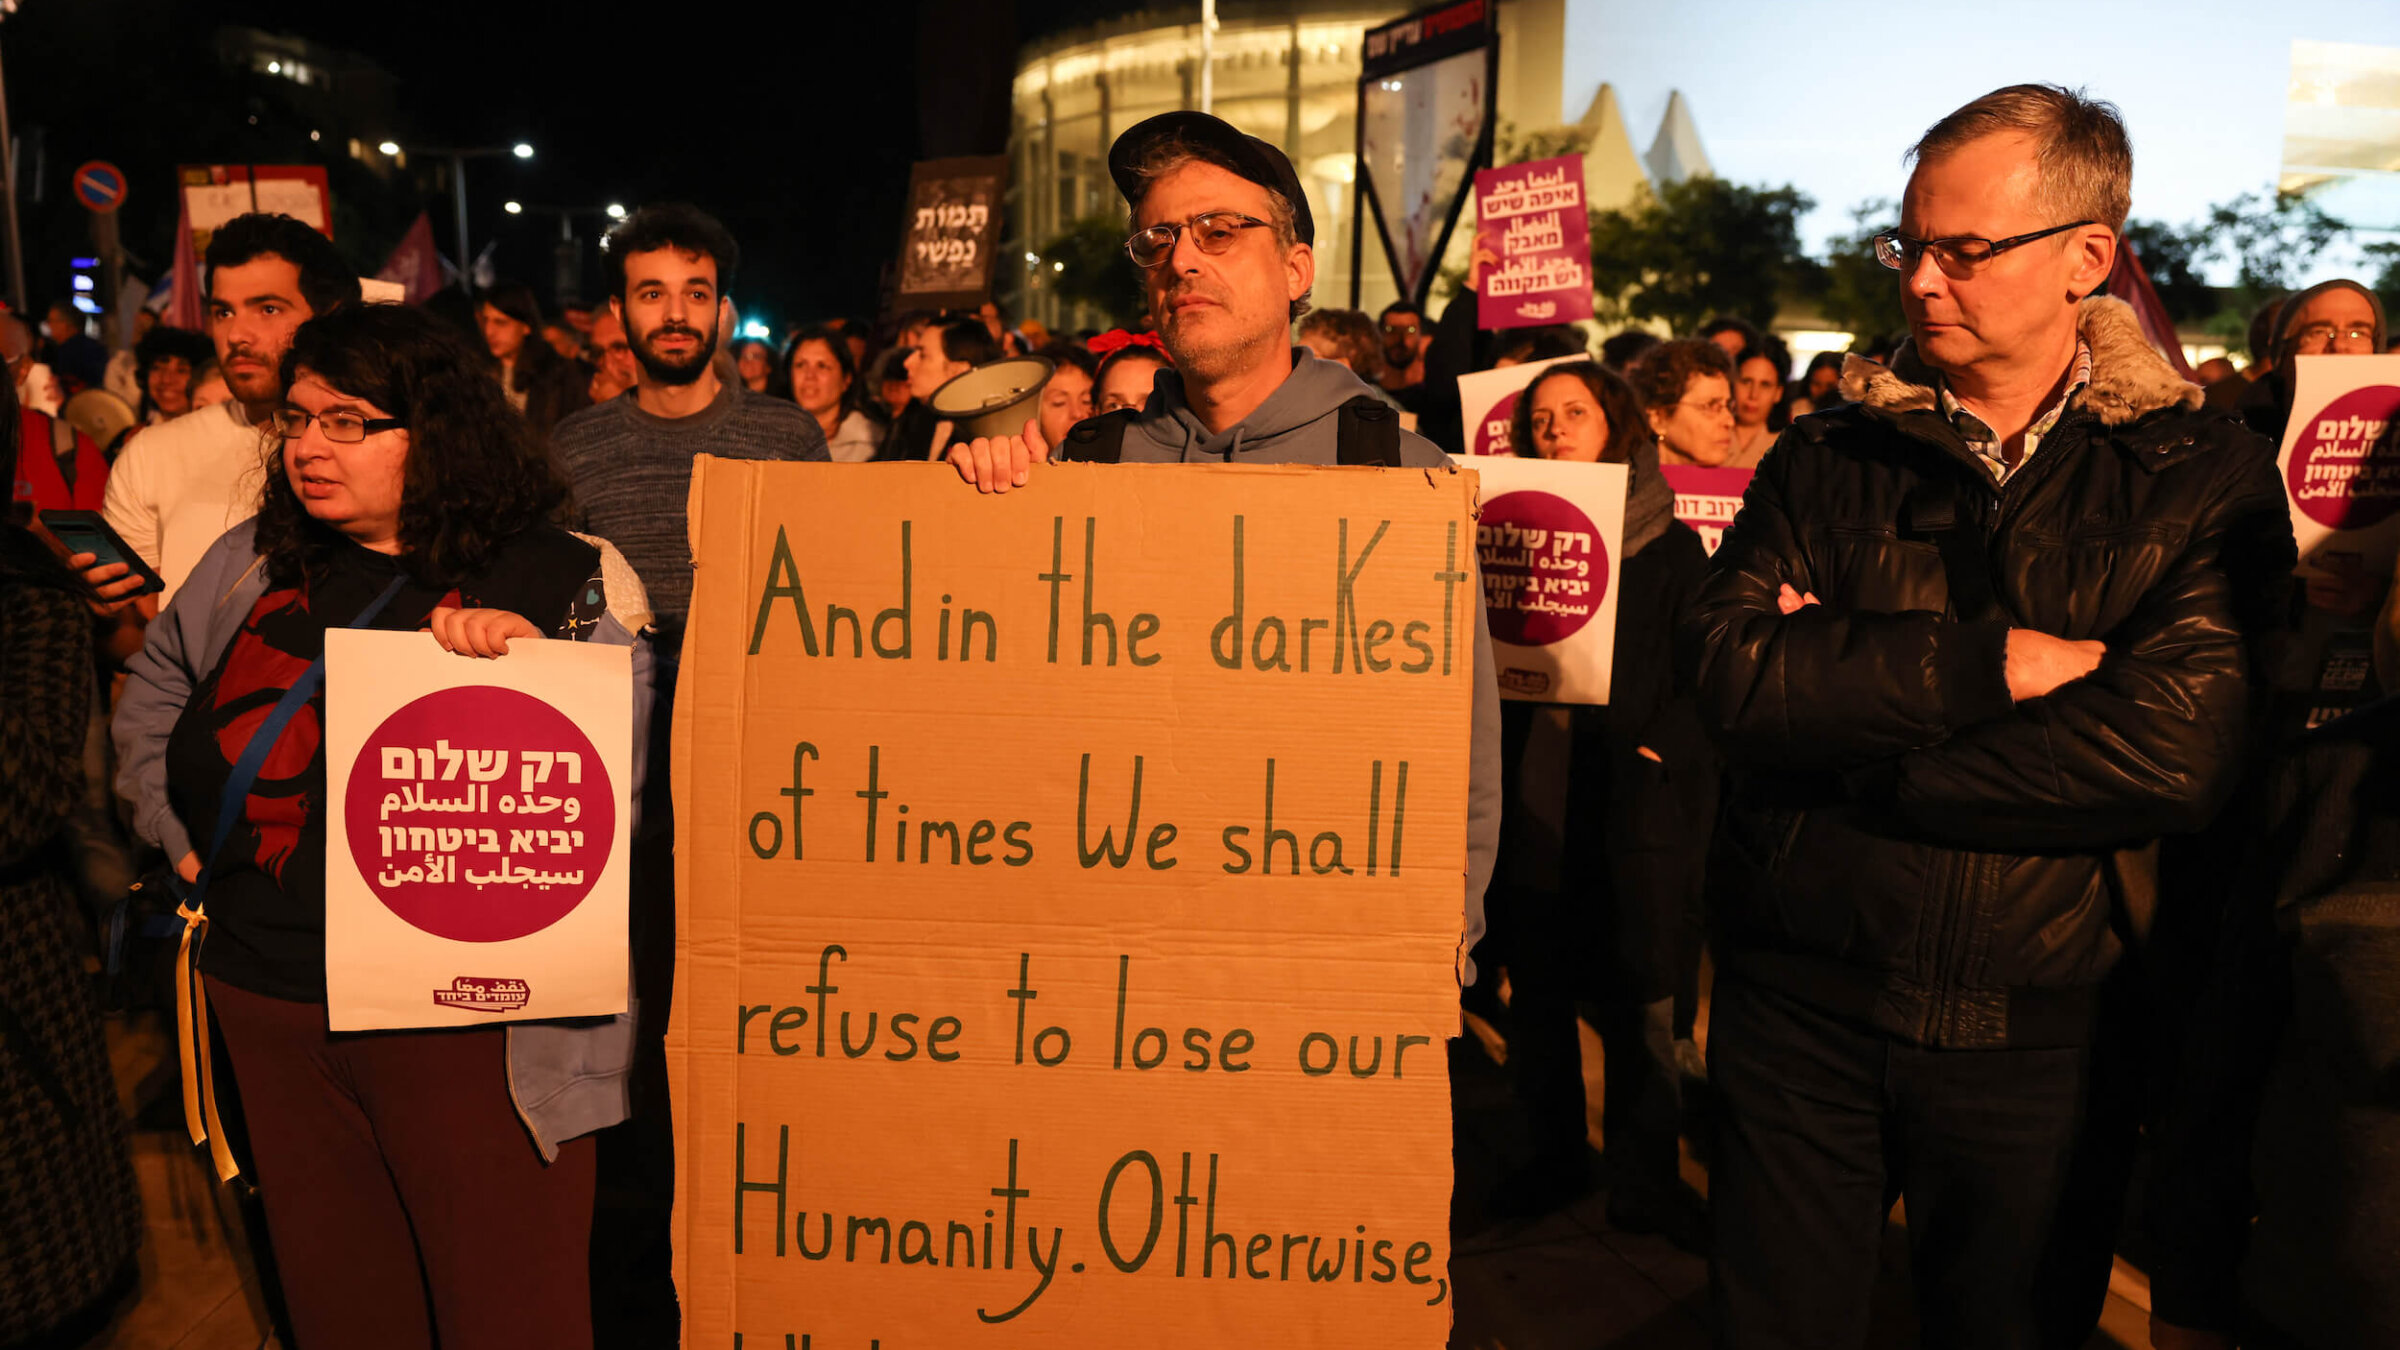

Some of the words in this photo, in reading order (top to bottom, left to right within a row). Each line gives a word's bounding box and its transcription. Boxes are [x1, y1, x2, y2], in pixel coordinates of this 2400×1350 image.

[1486, 196, 1524, 214] שיש
[1530, 188, 1574, 207] איפה
[1508, 232, 1559, 253] מאבק
[1493, 275, 1548, 292] תקווה
[1555, 271, 1577, 285] יש
[2316, 414, 2389, 440] שלום
[2309, 440, 2375, 463] السلام
[1552, 530, 1591, 557] רק
[1479, 546, 1535, 568] السلا
[1539, 555, 1589, 577] وحده
[748, 521, 911, 659] And
[939, 595, 996, 661] in
[1039, 517, 1160, 666] the
[1482, 573, 1540, 592] ביטח
[1544, 577, 1590, 596] יביא
[1516, 593, 1589, 618] سيجلب
[382, 740, 508, 781] שלום
[521, 751, 581, 791] רק
[381, 783, 488, 820] السلام
[499, 793, 580, 823] وحده
[749, 742, 818, 860] of
[856, 746, 1033, 866] times
[1223, 759, 1408, 876] shall
[379, 827, 500, 856] ביטחון
[510, 830, 583, 853] יביא
[379, 854, 455, 887] الأمن
[465, 857, 583, 890] سيجلب
[437, 991, 471, 1001] ביחד
[475, 992, 526, 1002] עומדים
[490, 981, 526, 992] نقف
[738, 945, 961, 1062] refuse
[1008, 953, 1070, 1067] to
[1114, 955, 1254, 1072] lose
[1299, 1033, 1430, 1078] our
[735, 1122, 1085, 1323] Humanity.
[1099, 1150, 1447, 1306] Otherwise,
